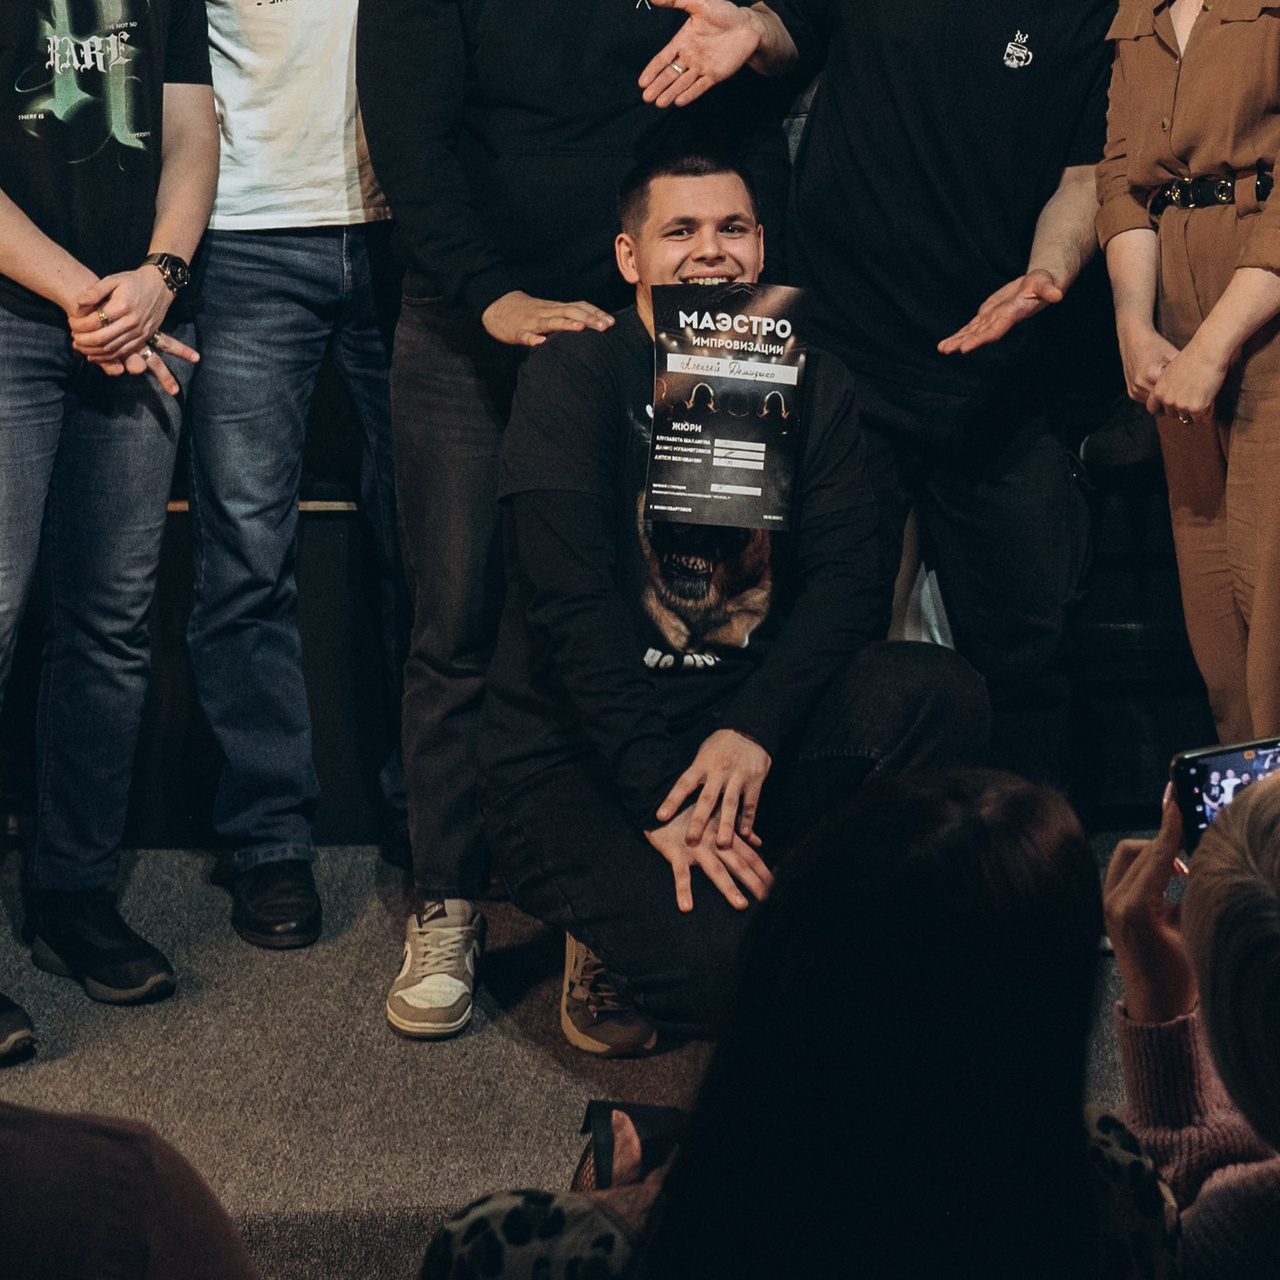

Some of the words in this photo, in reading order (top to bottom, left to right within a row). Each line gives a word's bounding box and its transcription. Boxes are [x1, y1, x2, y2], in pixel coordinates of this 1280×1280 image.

[678, 310, 792, 339] МАЭСТРО
[692, 336, 784, 355] ИМПРОВИЗАЦИИ
[672, 422, 702, 433] ЖЮРИ
